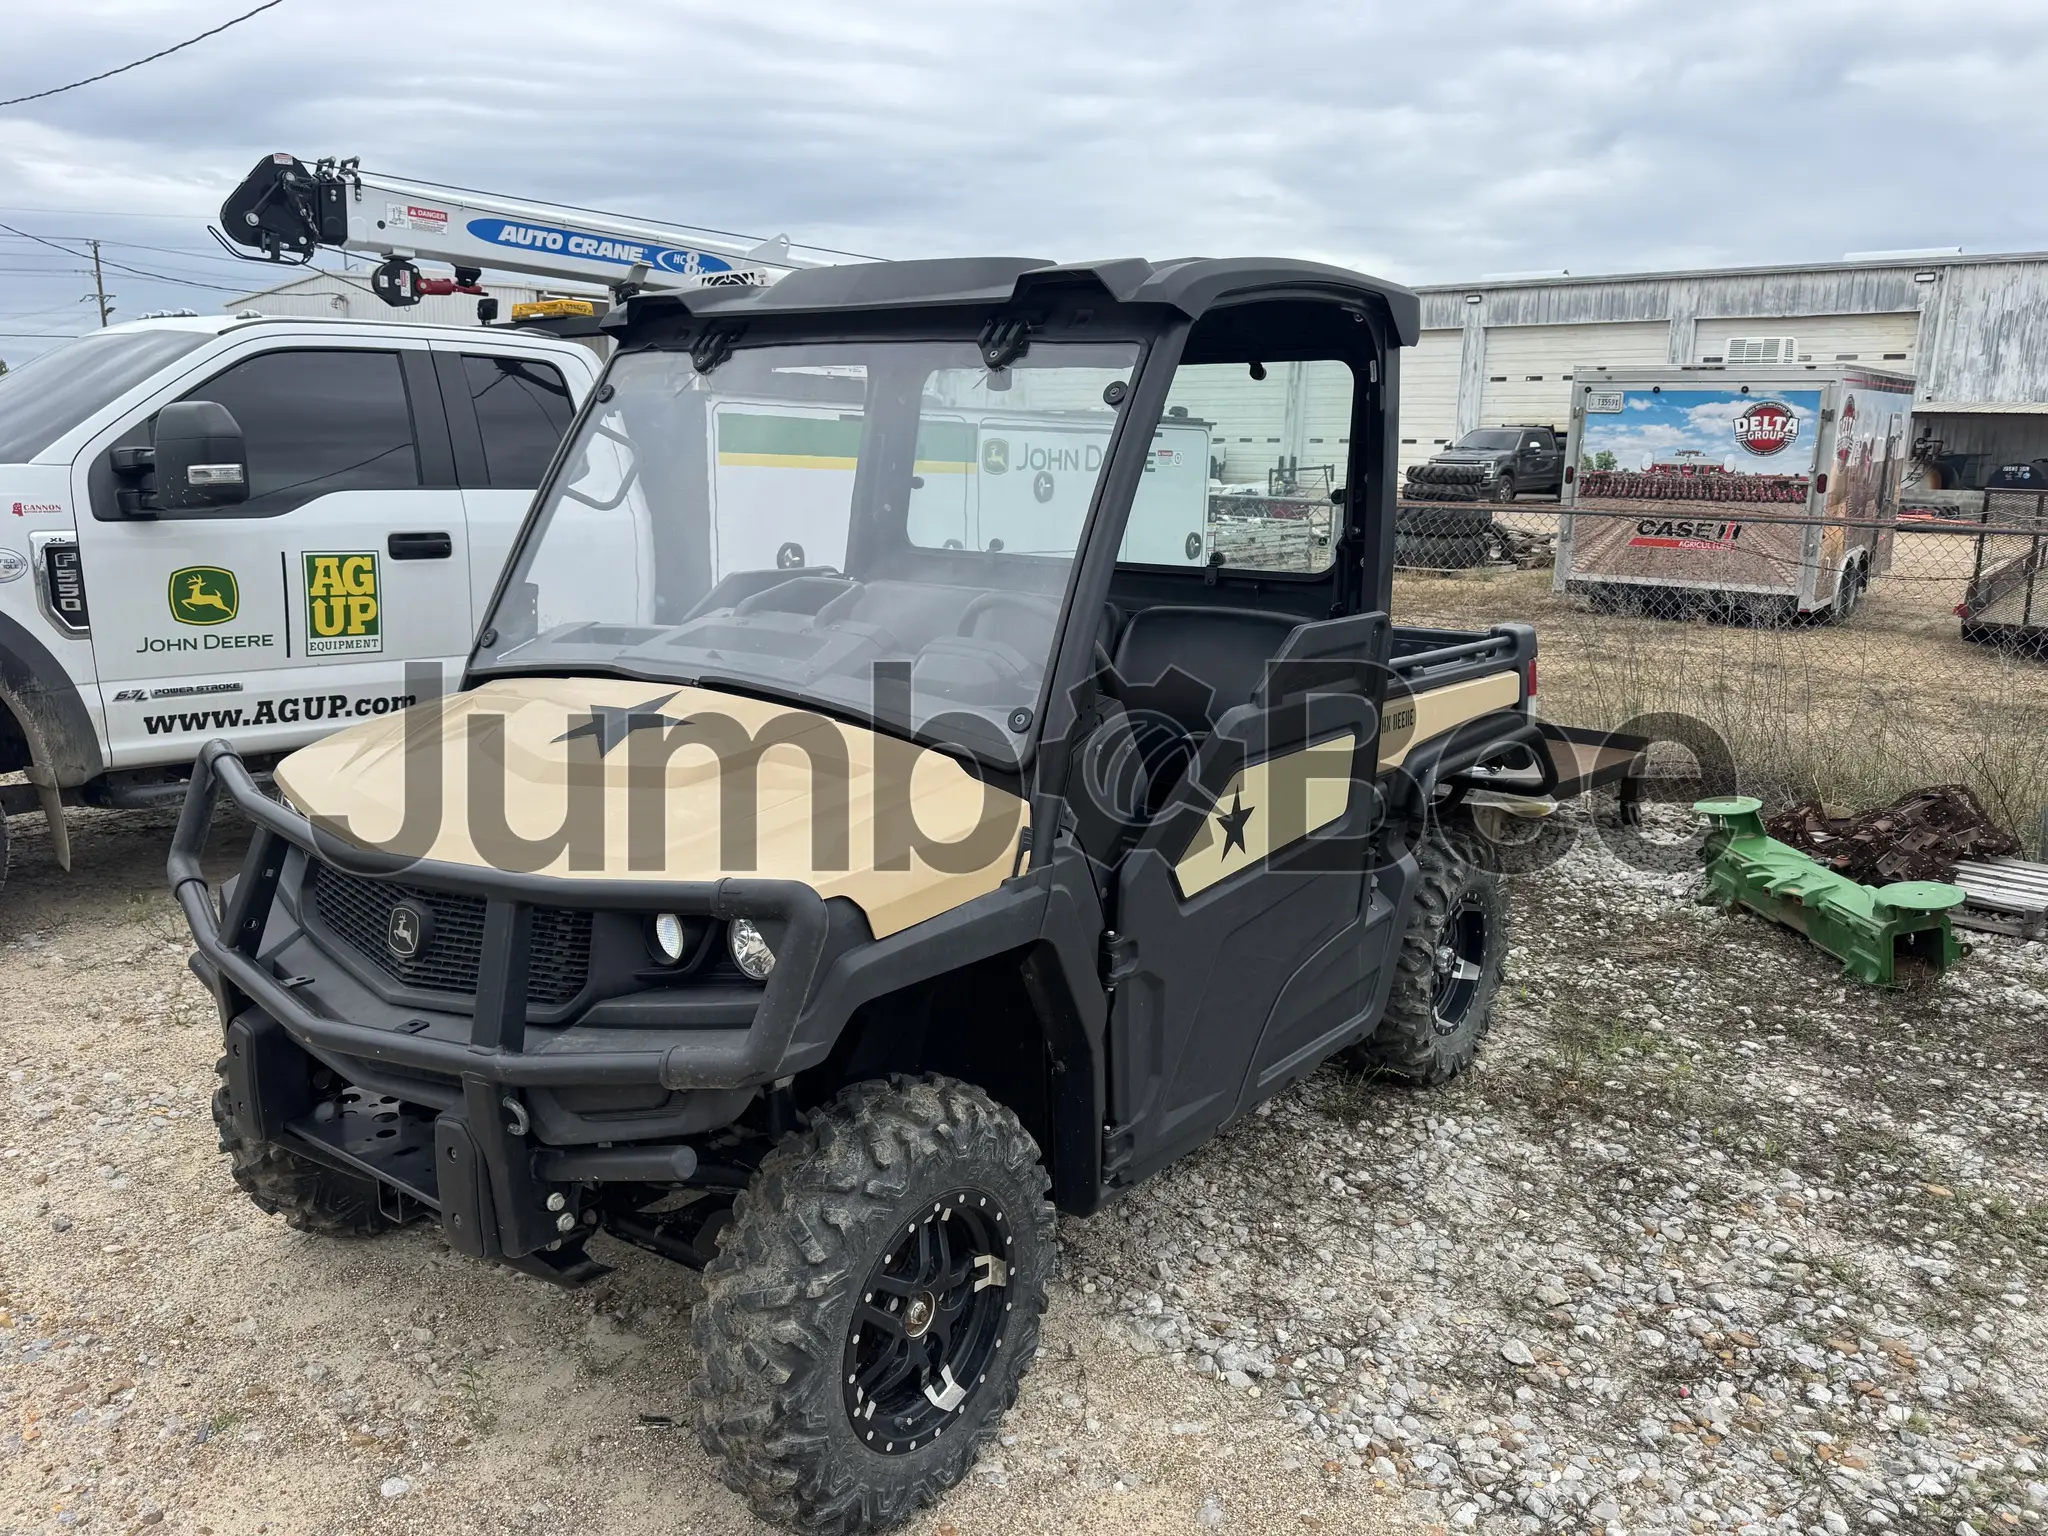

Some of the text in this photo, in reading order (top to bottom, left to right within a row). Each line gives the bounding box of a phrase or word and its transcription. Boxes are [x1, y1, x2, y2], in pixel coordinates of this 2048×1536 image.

[417, 209, 446, 220] DANGER
[497, 224, 645, 262] AUTO CRANE
[1733, 415, 1799, 434] DELTA
[1747, 431, 1785, 440] GROUP
[1016, 442, 1079, 471] JOHN
[1637, 519, 1714, 539] CASE
[310, 556, 375, 597] AG
[311, 596, 377, 637] UP
[136, 634, 274, 653] JOHN DEERE
[309, 639, 379, 652] EQUIPMENT
[154, 686, 194, 696] POWER
[196, 682, 241, 692] STROKE
[143, 693, 417, 735] www.AGUP.com
